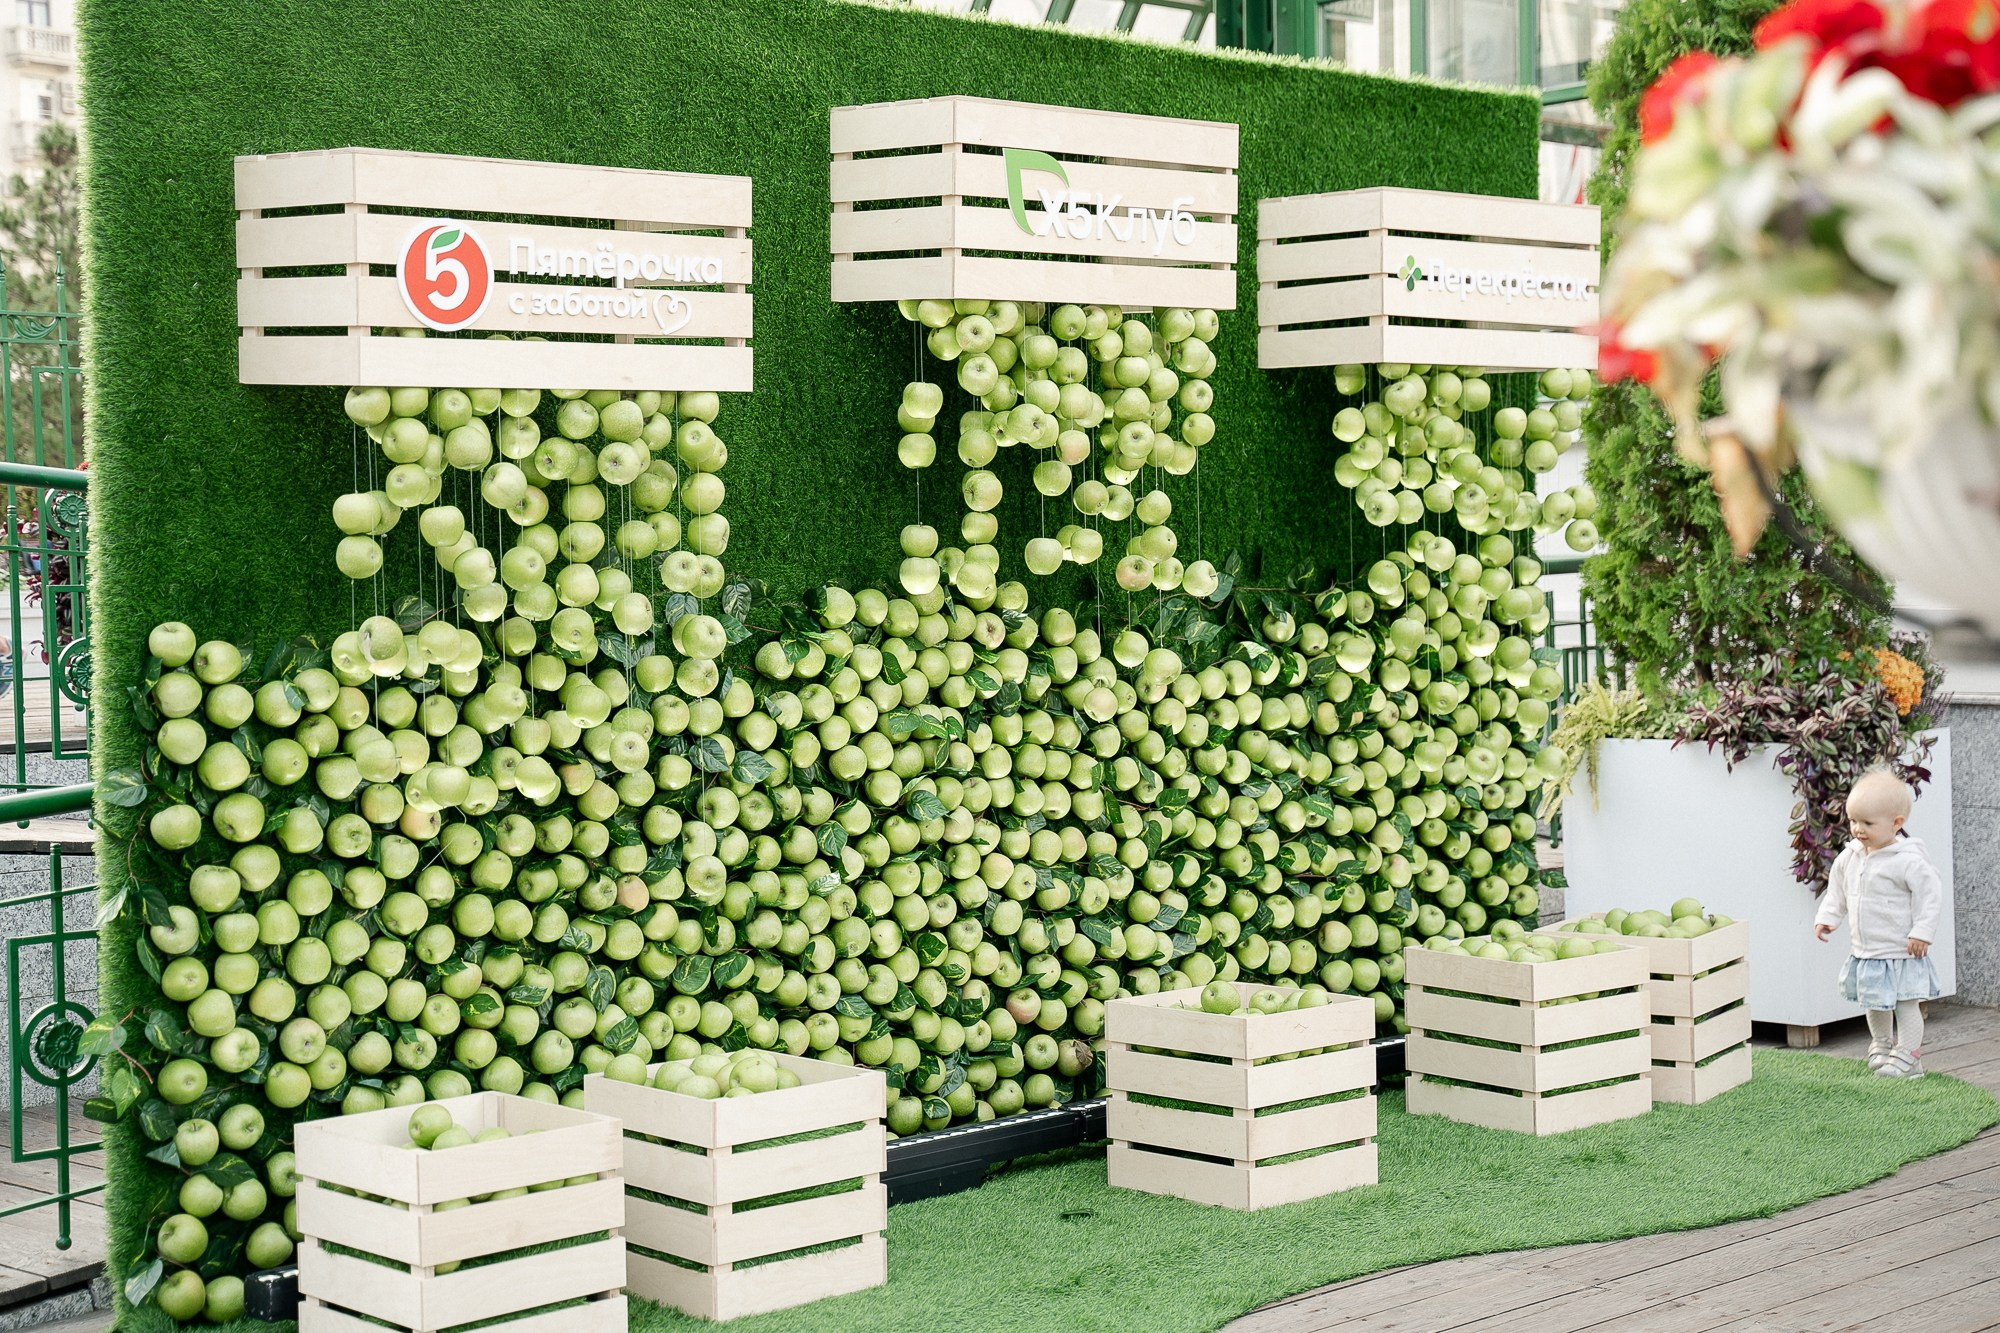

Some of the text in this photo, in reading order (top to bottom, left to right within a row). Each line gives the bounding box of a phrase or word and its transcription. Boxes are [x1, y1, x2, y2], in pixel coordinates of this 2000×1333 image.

[425, 226, 470, 311] 5
[508, 237, 724, 290] Пятёрочка
[1427, 258, 1591, 304] Перекрёсток
[530, 288, 648, 318] заботой
